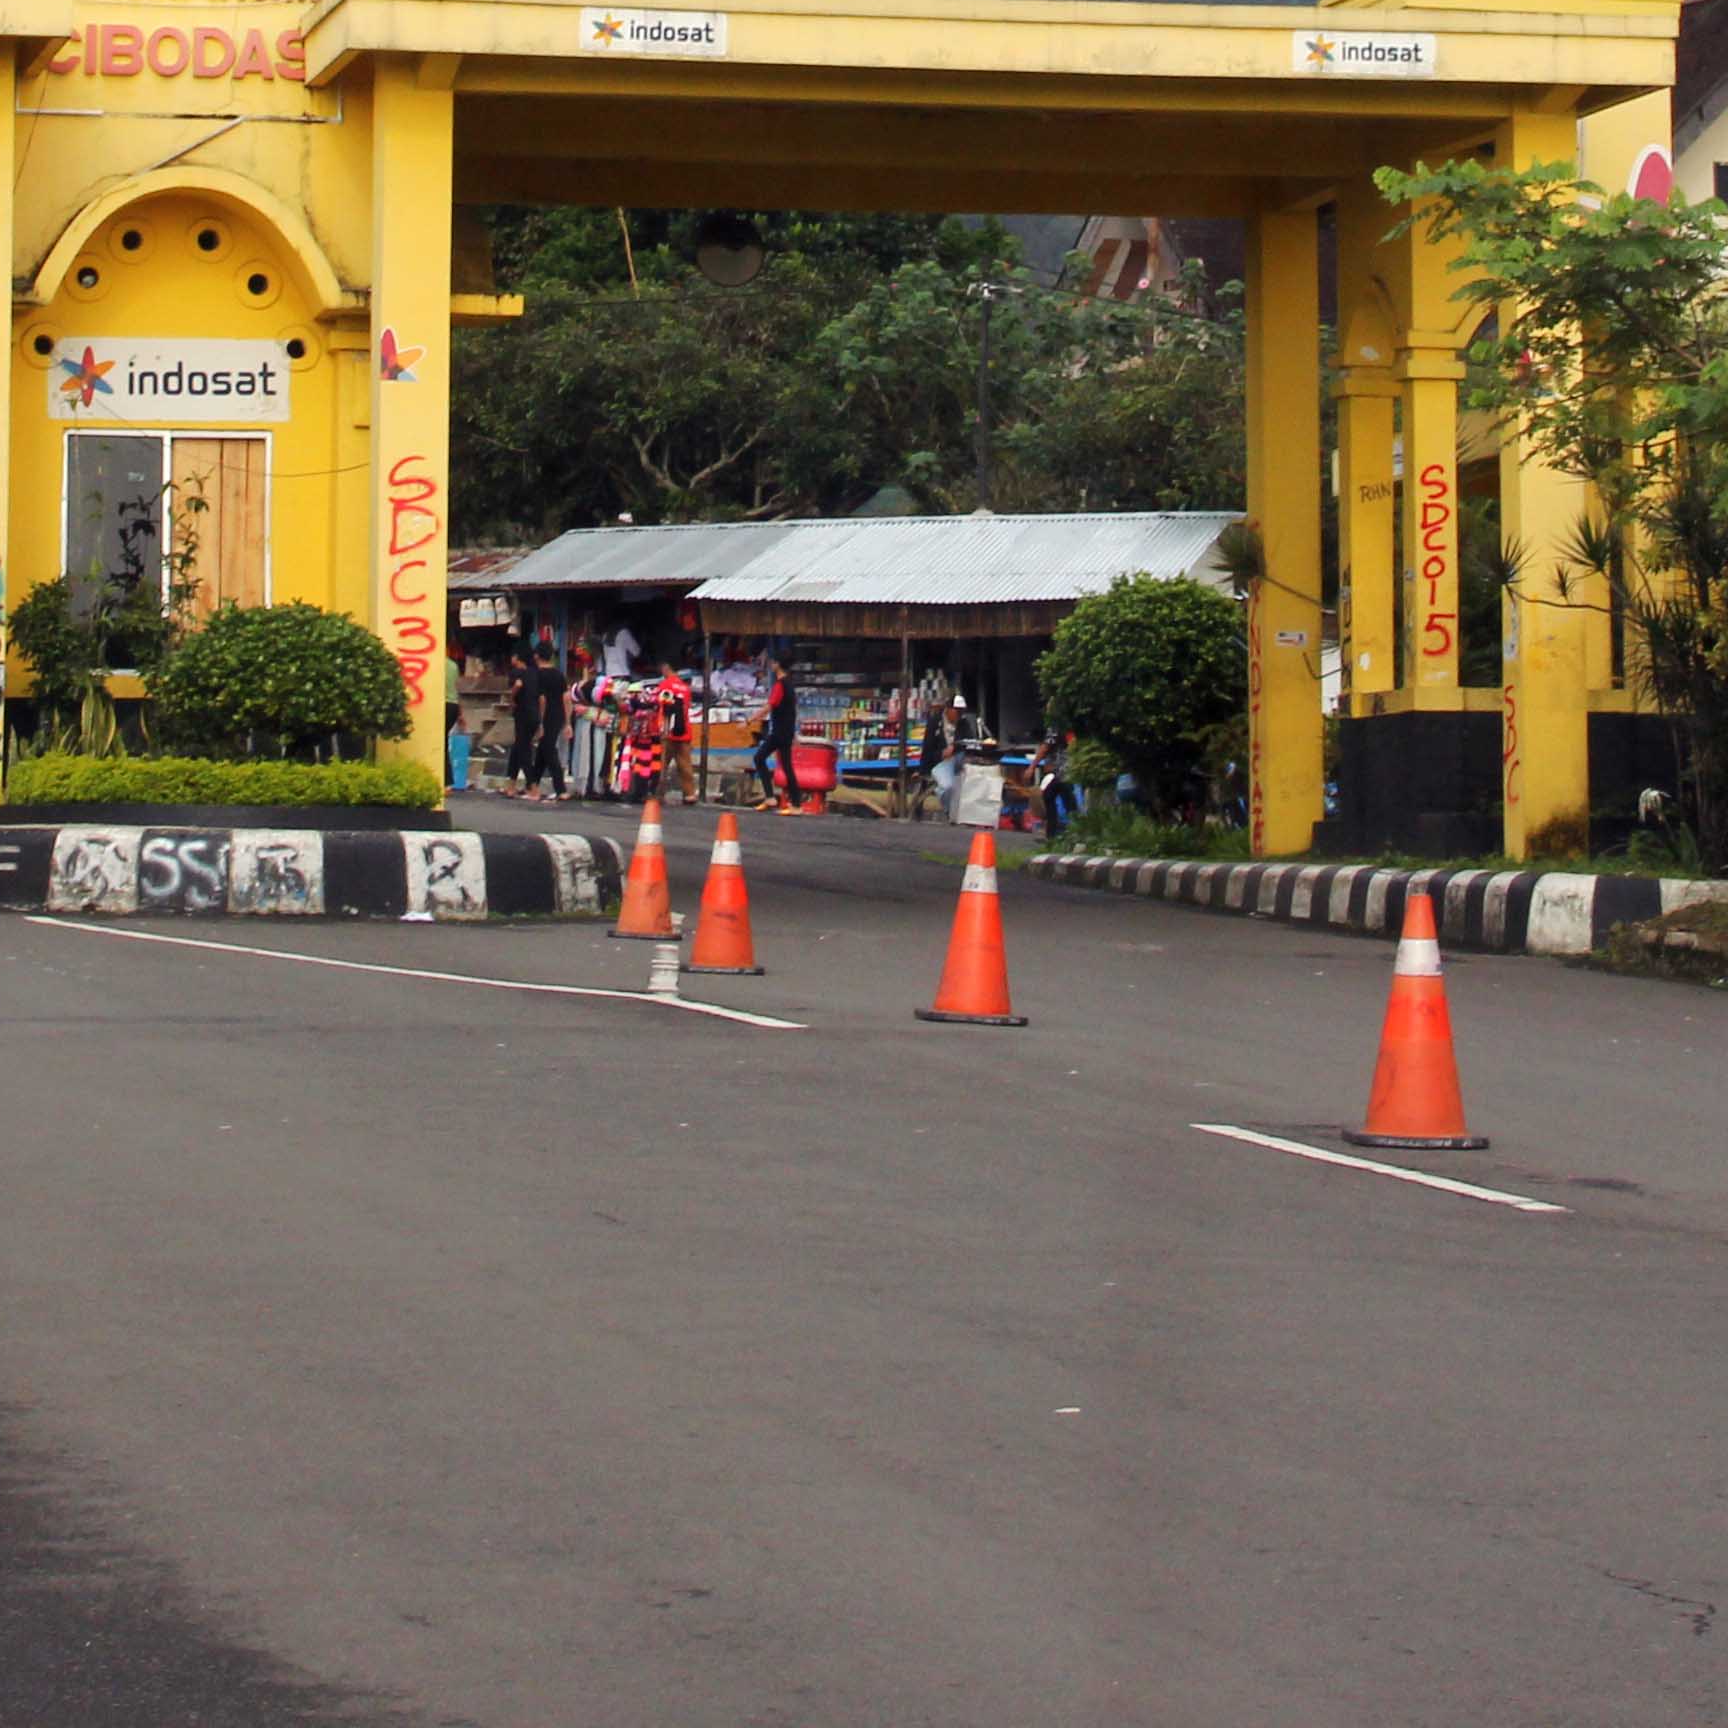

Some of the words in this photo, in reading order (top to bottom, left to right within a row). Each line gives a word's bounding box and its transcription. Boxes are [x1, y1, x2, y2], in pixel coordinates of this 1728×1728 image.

[630, 20, 715, 44] indosat
[1341, 41, 1423, 63] indosat
[128, 360, 277, 396] indosat
